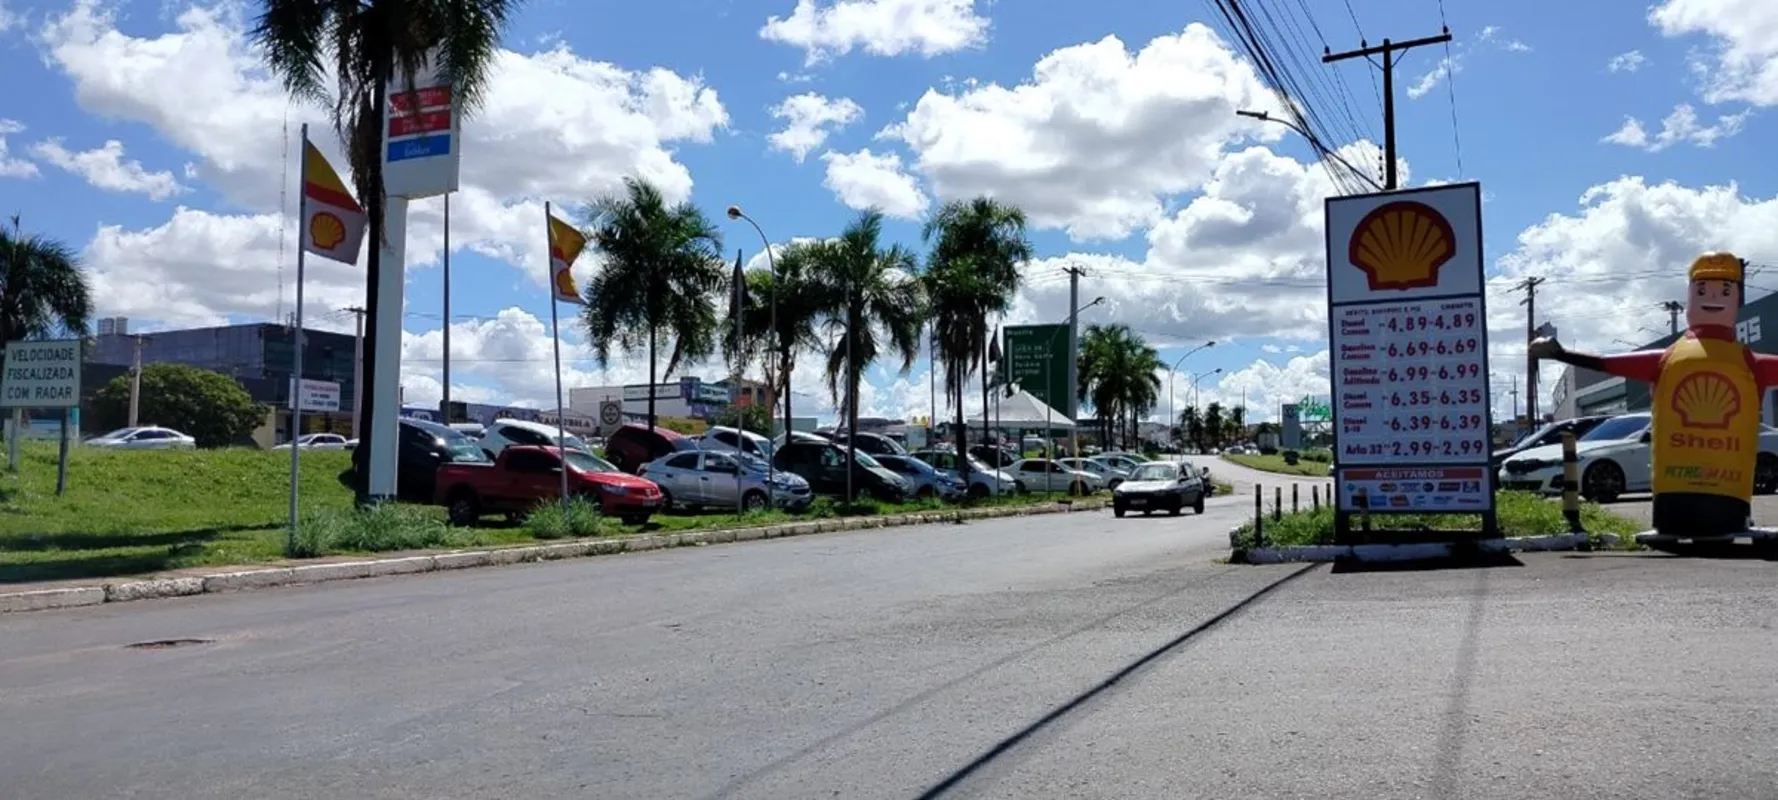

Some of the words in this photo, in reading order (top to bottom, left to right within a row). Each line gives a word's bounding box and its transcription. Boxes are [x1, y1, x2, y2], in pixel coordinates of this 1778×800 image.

[11, 347, 75, 362] VELOCIDADE
[7, 366, 75, 380] FISCALIZADA
[7, 386, 30, 400] COM
[35, 386, 73, 400] RADAR
[1670, 432, 1740, 452] Shell
[1375, 469, 1444, 478] ACEITAMOS
